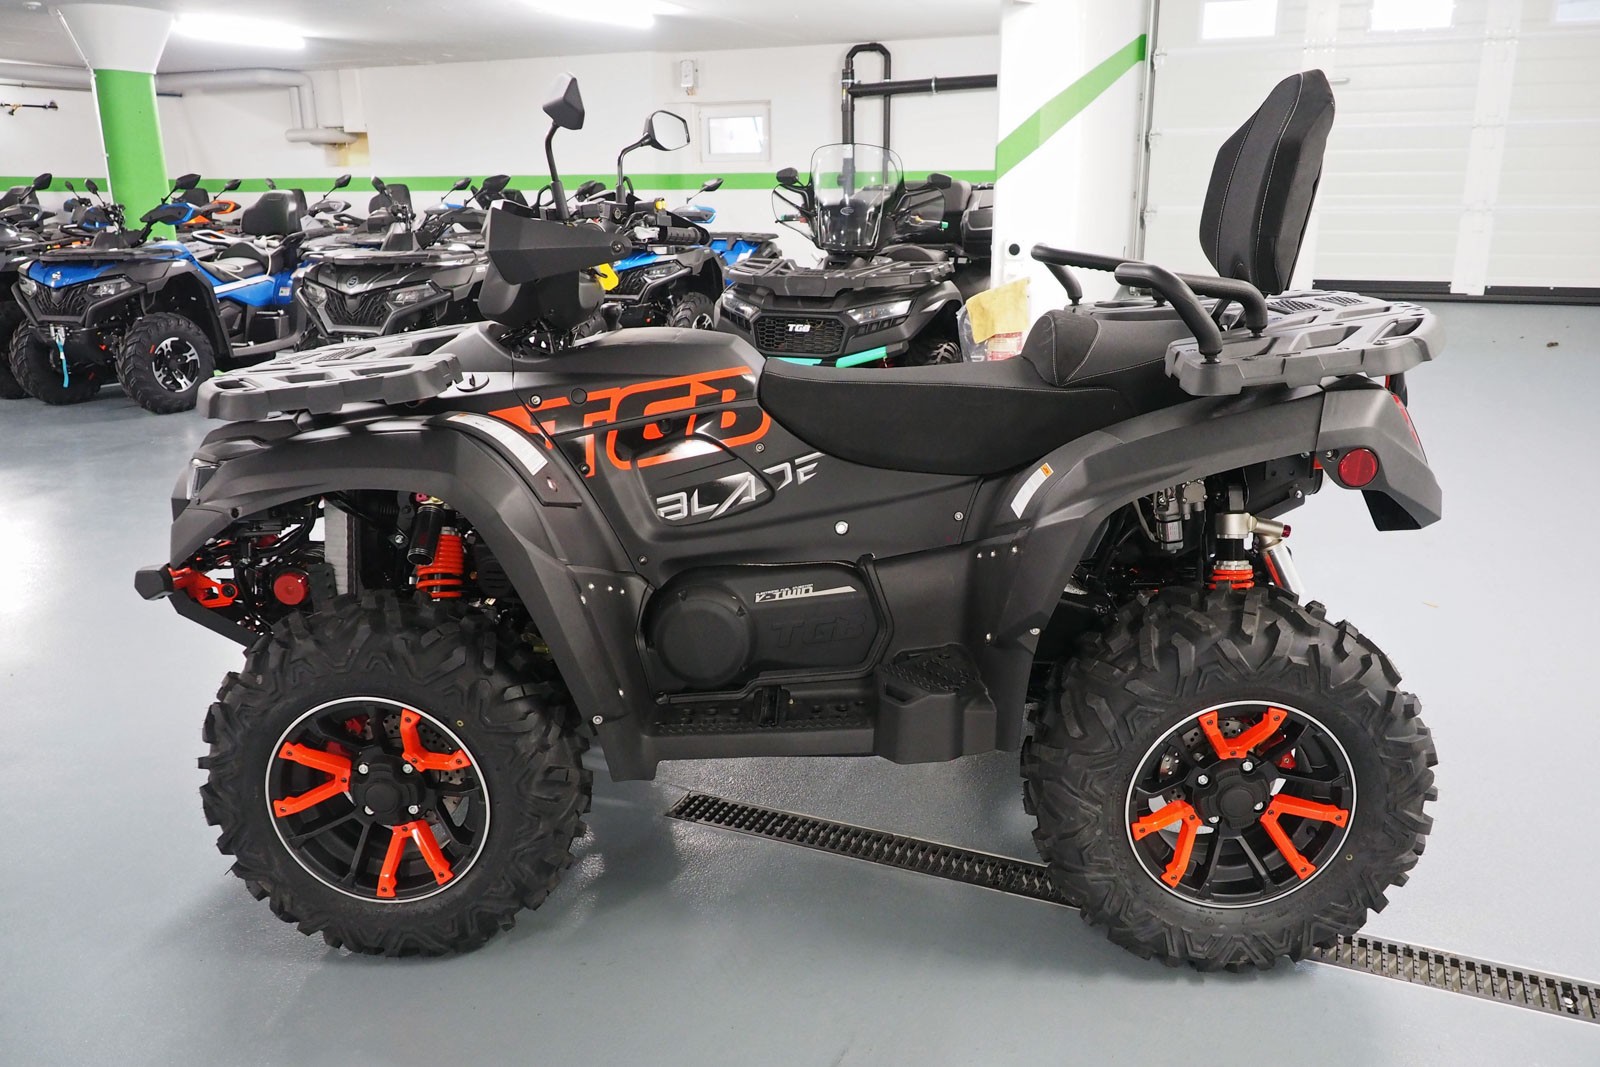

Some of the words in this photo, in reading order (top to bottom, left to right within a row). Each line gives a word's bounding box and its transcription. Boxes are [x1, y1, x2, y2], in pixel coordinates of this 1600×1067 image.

[787, 323, 811, 332] TGB
[488, 365, 772, 478] TGB
[656, 451, 828, 521] BLADE
